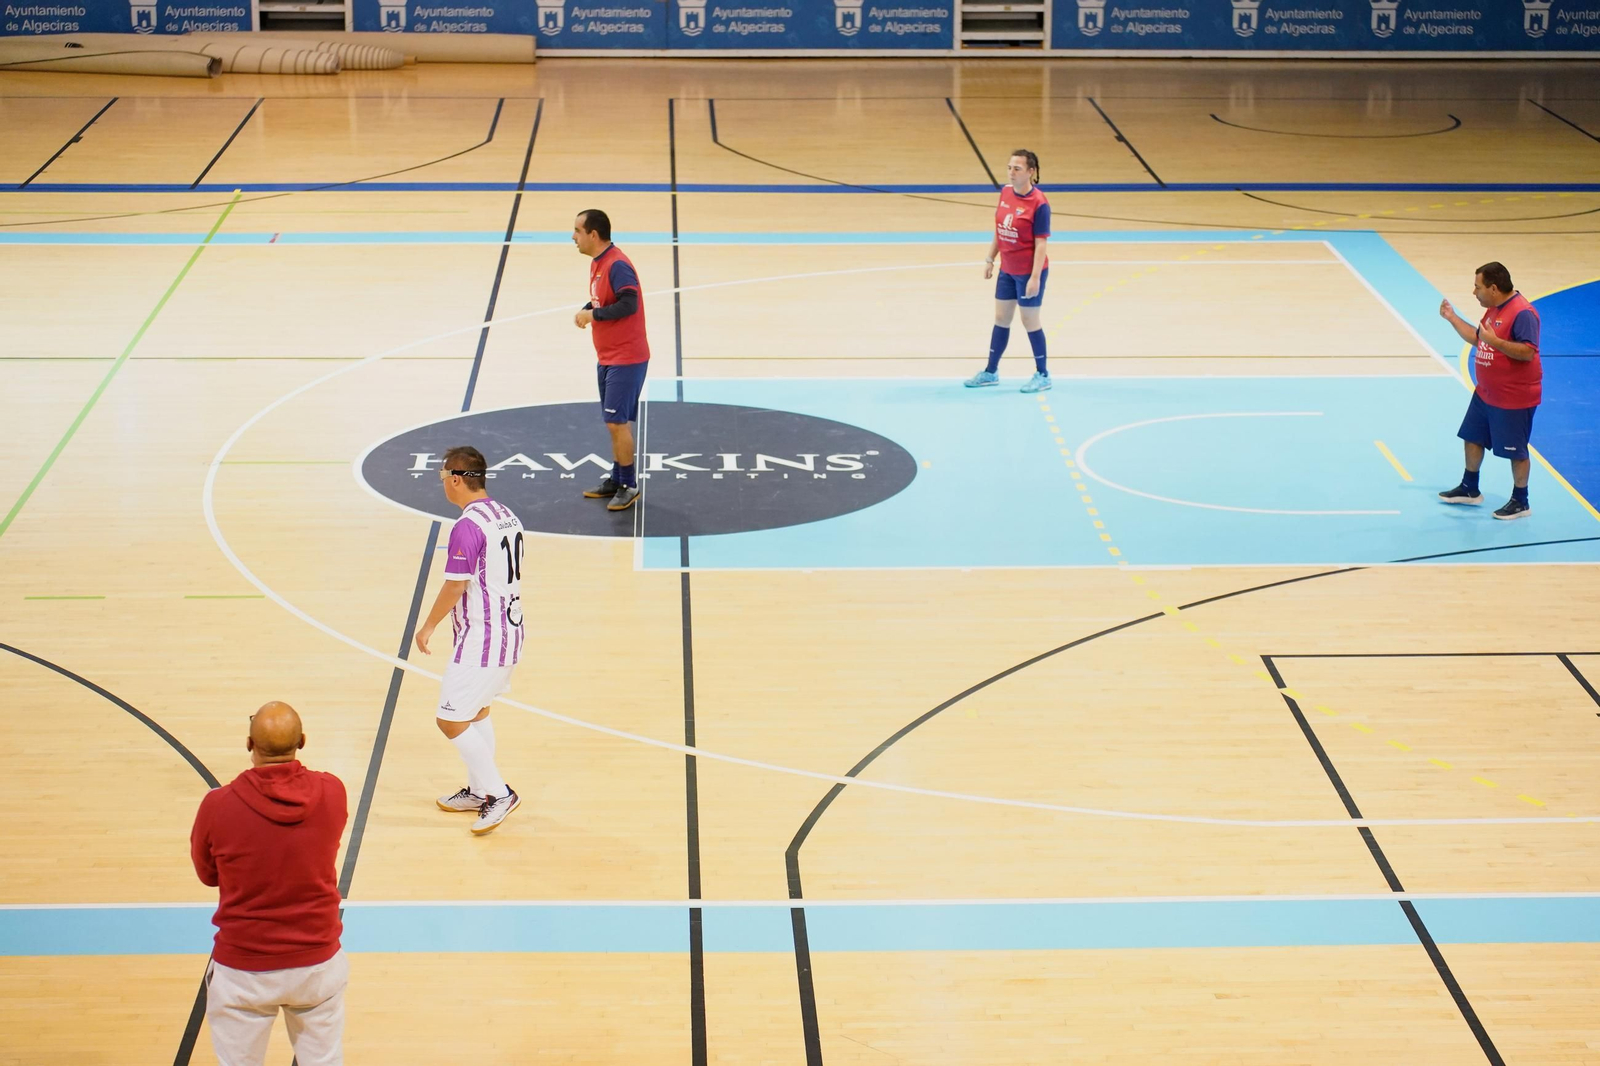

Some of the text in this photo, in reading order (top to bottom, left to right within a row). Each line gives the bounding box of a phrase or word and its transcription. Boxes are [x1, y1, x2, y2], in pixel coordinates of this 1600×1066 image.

[5, 4, 86, 18] Ayuntamiento
[164, 5, 246, 19] Ayuntamiento
[413, 5, 495, 19] Ayuntamiento
[571, 6, 651, 19] Ayuntamiento
[712, 6, 792, 19] Ayuntamiento
[868, 6, 949, 19] Ayuntamiento
[1110, 7, 1190, 19] Ayuntamiento
[1264, 8, 1344, 20] Ayuntamiento
[1403, 9, 1482, 20] Ayuntamiento
[6, 19, 80, 34] de Algeciras
[165, 20, 239, 32] de Algeciras
[414, 20, 488, 33] de Algeciras
[571, 21, 644, 35] de Algeciras
[712, 21, 786, 35] de Algeciras
[868, 21, 941, 35] de Algeciras
[1110, 21, 1182, 35] de Algeciras
[1264, 22, 1336, 36] de Algeciras
[1403, 23, 1474, 36] de Algeciras
[1555, 25, 1568, 35] de
[500, 531, 524, 585] 10
